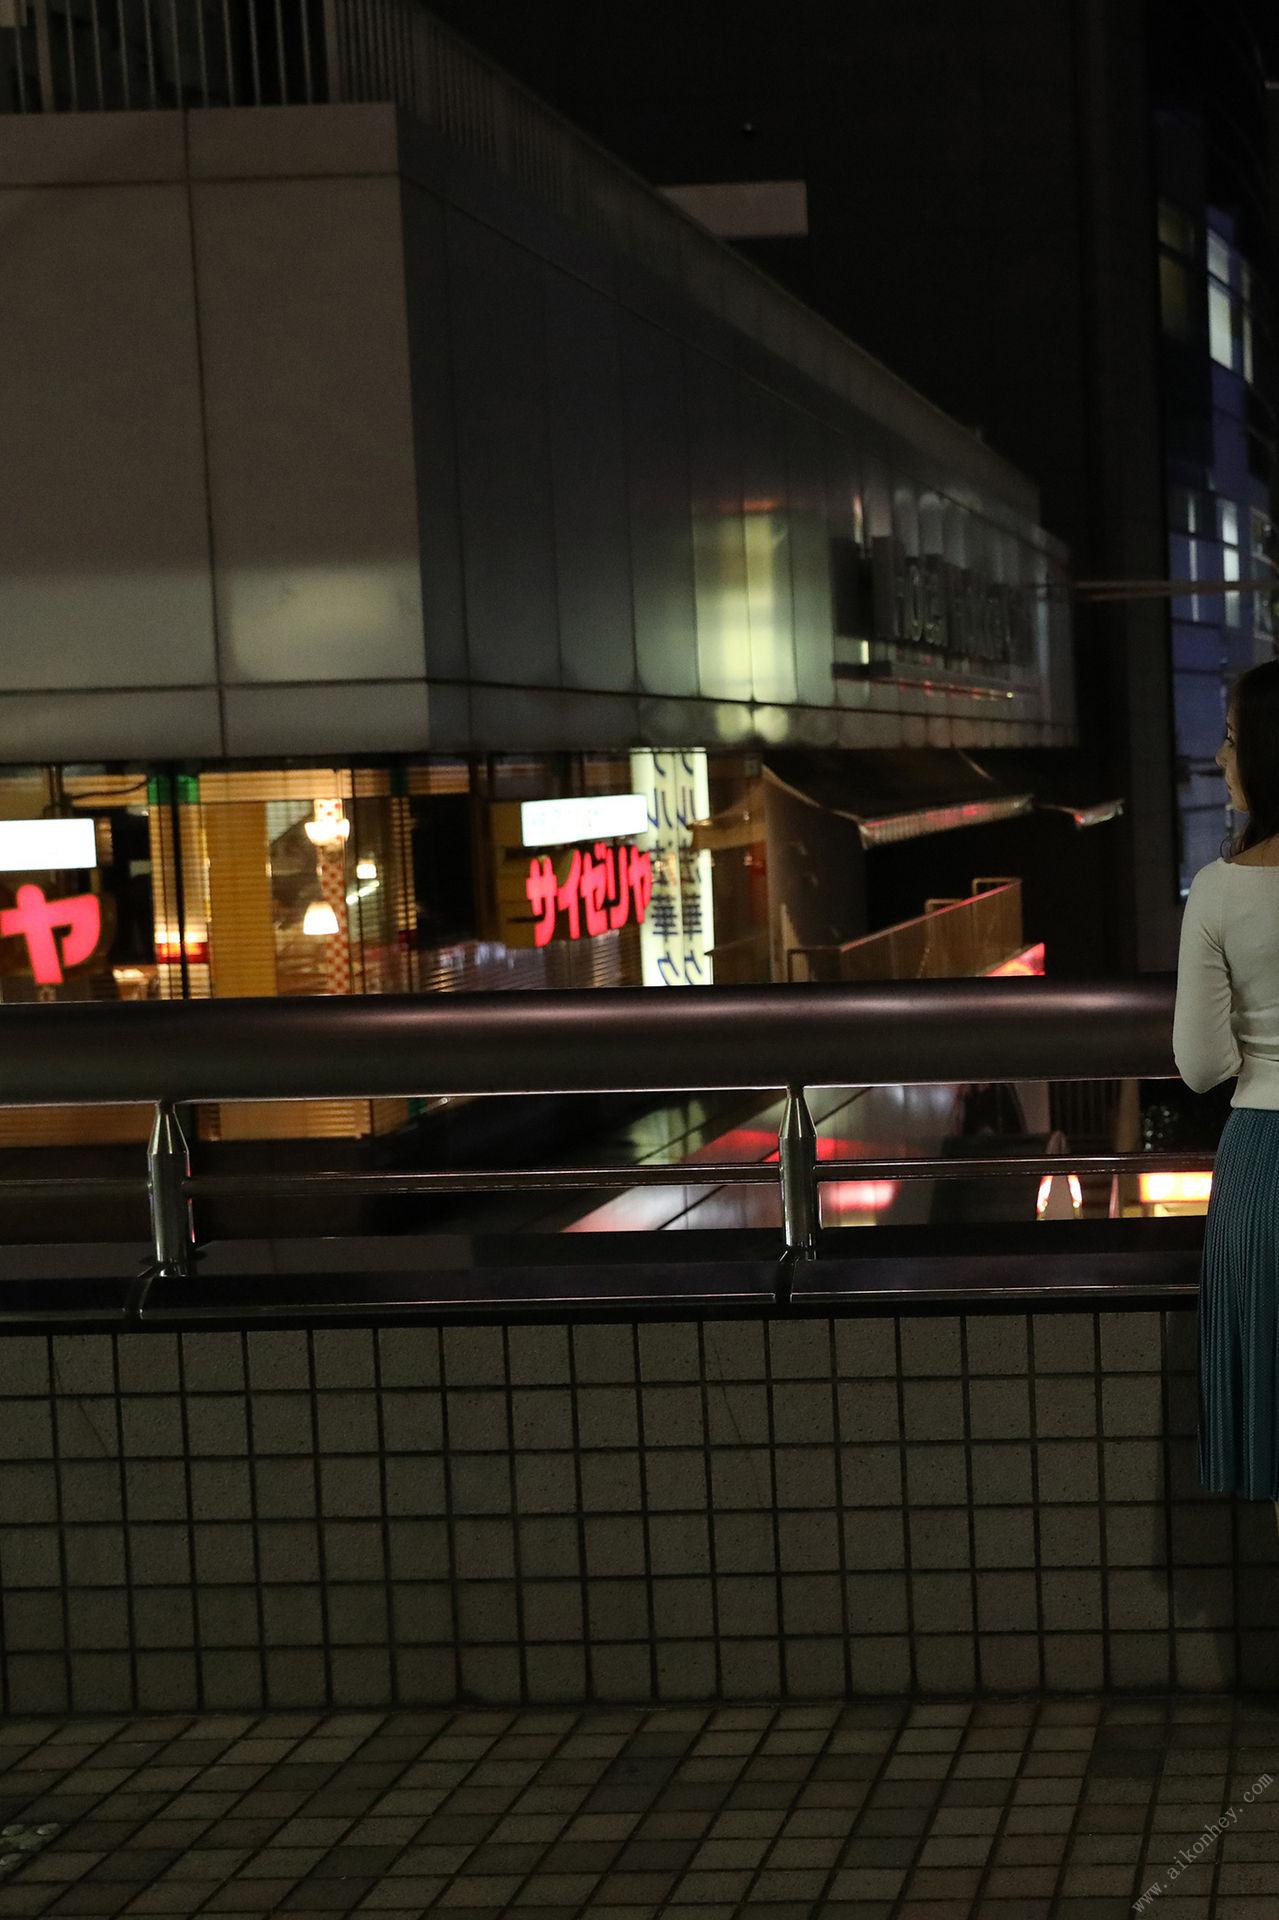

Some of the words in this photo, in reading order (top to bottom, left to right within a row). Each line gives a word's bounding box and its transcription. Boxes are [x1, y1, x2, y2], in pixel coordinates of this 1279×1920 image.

[526, 842, 652, 947] サイゼリヤ
